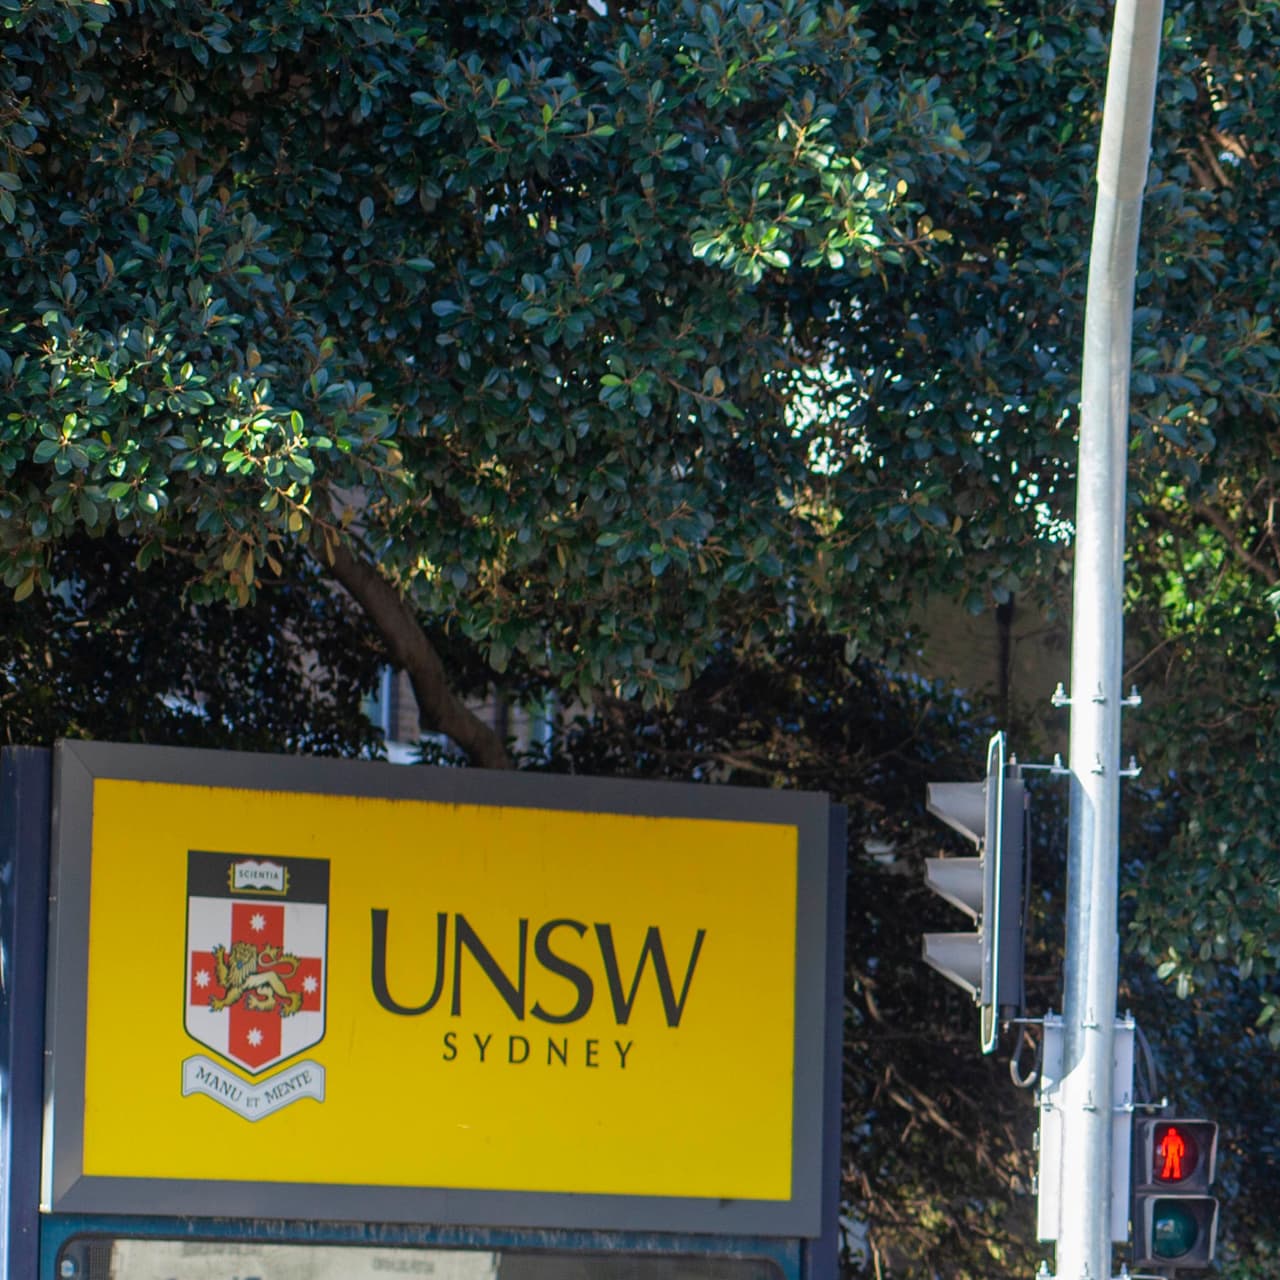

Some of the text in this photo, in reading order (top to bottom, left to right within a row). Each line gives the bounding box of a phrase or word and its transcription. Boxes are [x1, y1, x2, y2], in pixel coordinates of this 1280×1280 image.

[239, 869, 279, 880] SCIENTIA
[370, 907, 707, 1028] UNSW
[442, 1031, 633, 1069] SYDNEY
[195, 1065, 313, 1108] MANU ET MENTE
